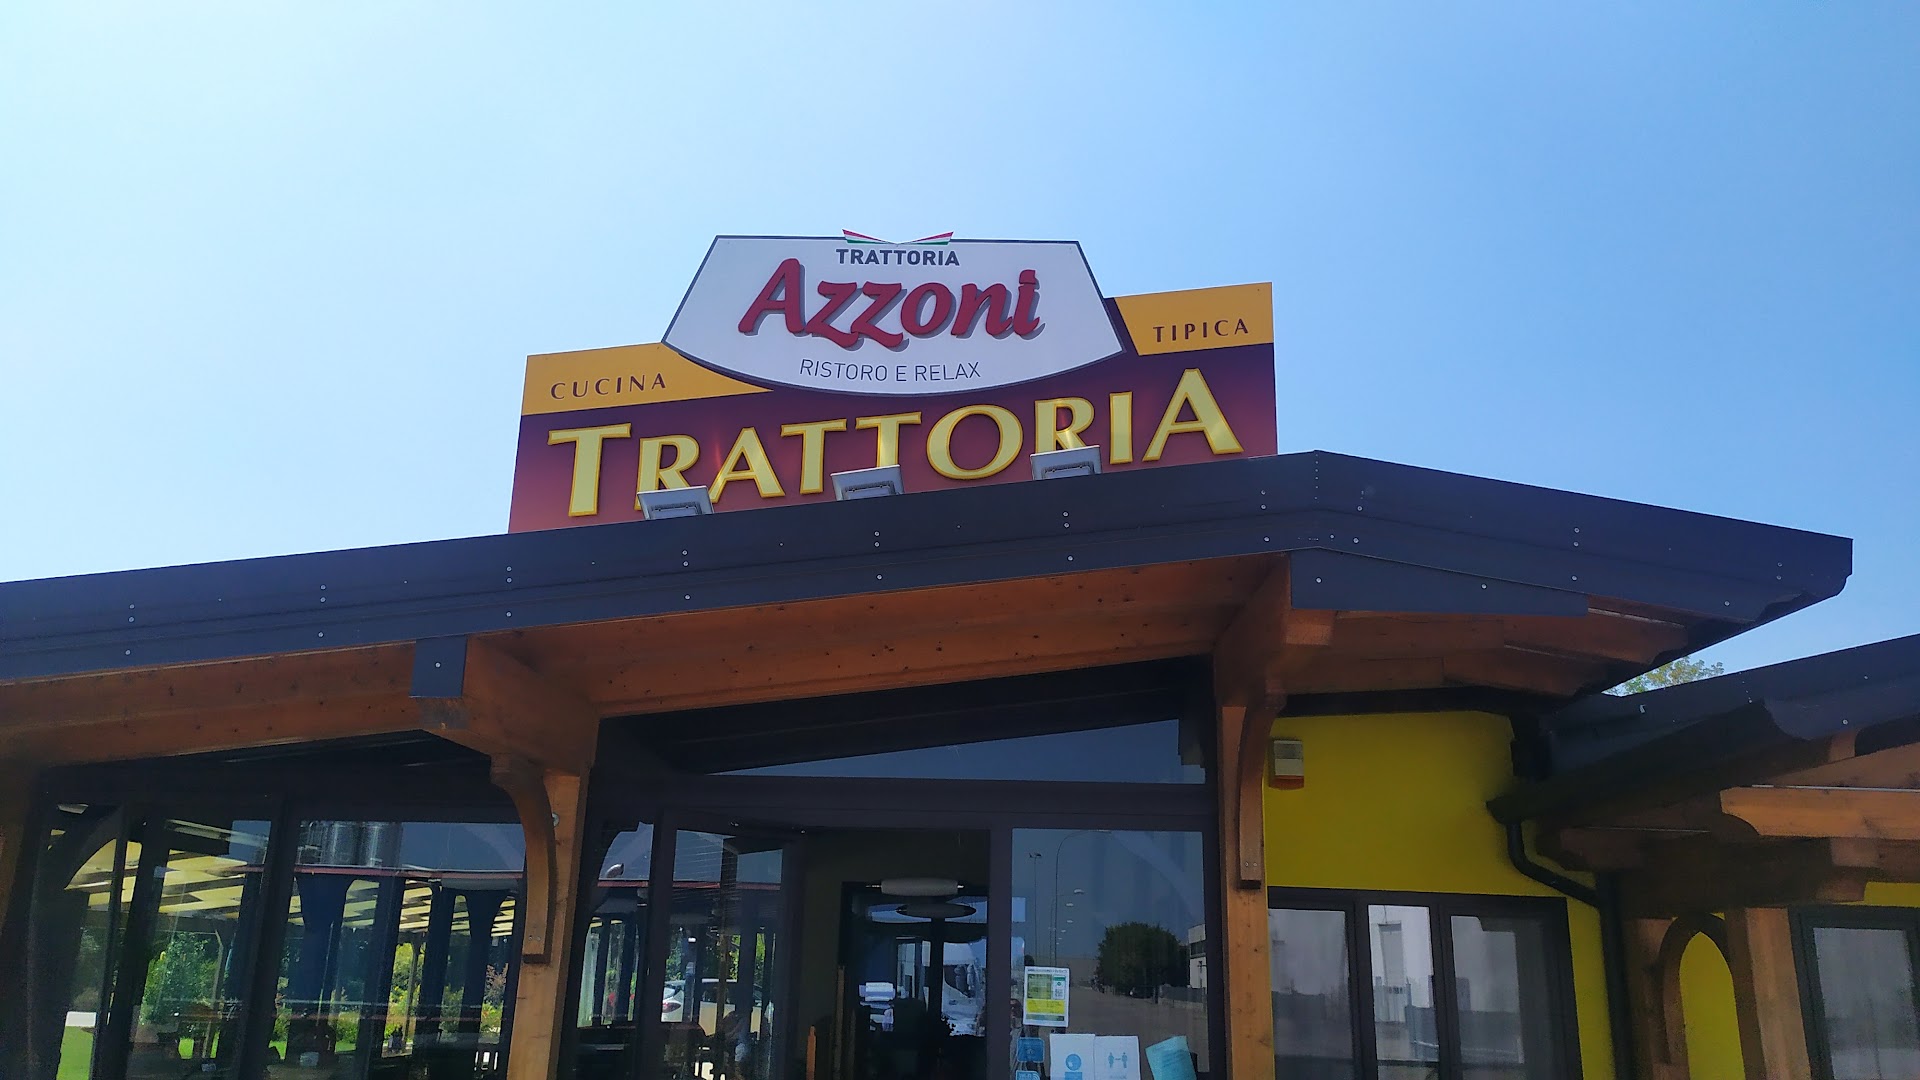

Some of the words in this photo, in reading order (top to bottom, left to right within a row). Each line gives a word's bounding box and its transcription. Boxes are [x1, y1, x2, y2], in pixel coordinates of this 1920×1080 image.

[836, 248, 960, 267] TRATTORIA
[738, 258, 1044, 350] Azzoni
[1153, 318, 1249, 342] TIPICA
[800, 358, 890, 382] RISTORO
[896, 365, 906, 382] E
[915, 361, 981, 382] RELAX
[550, 373, 667, 399] CUCINA
[547, 368, 1244, 517] TRATTORIA
